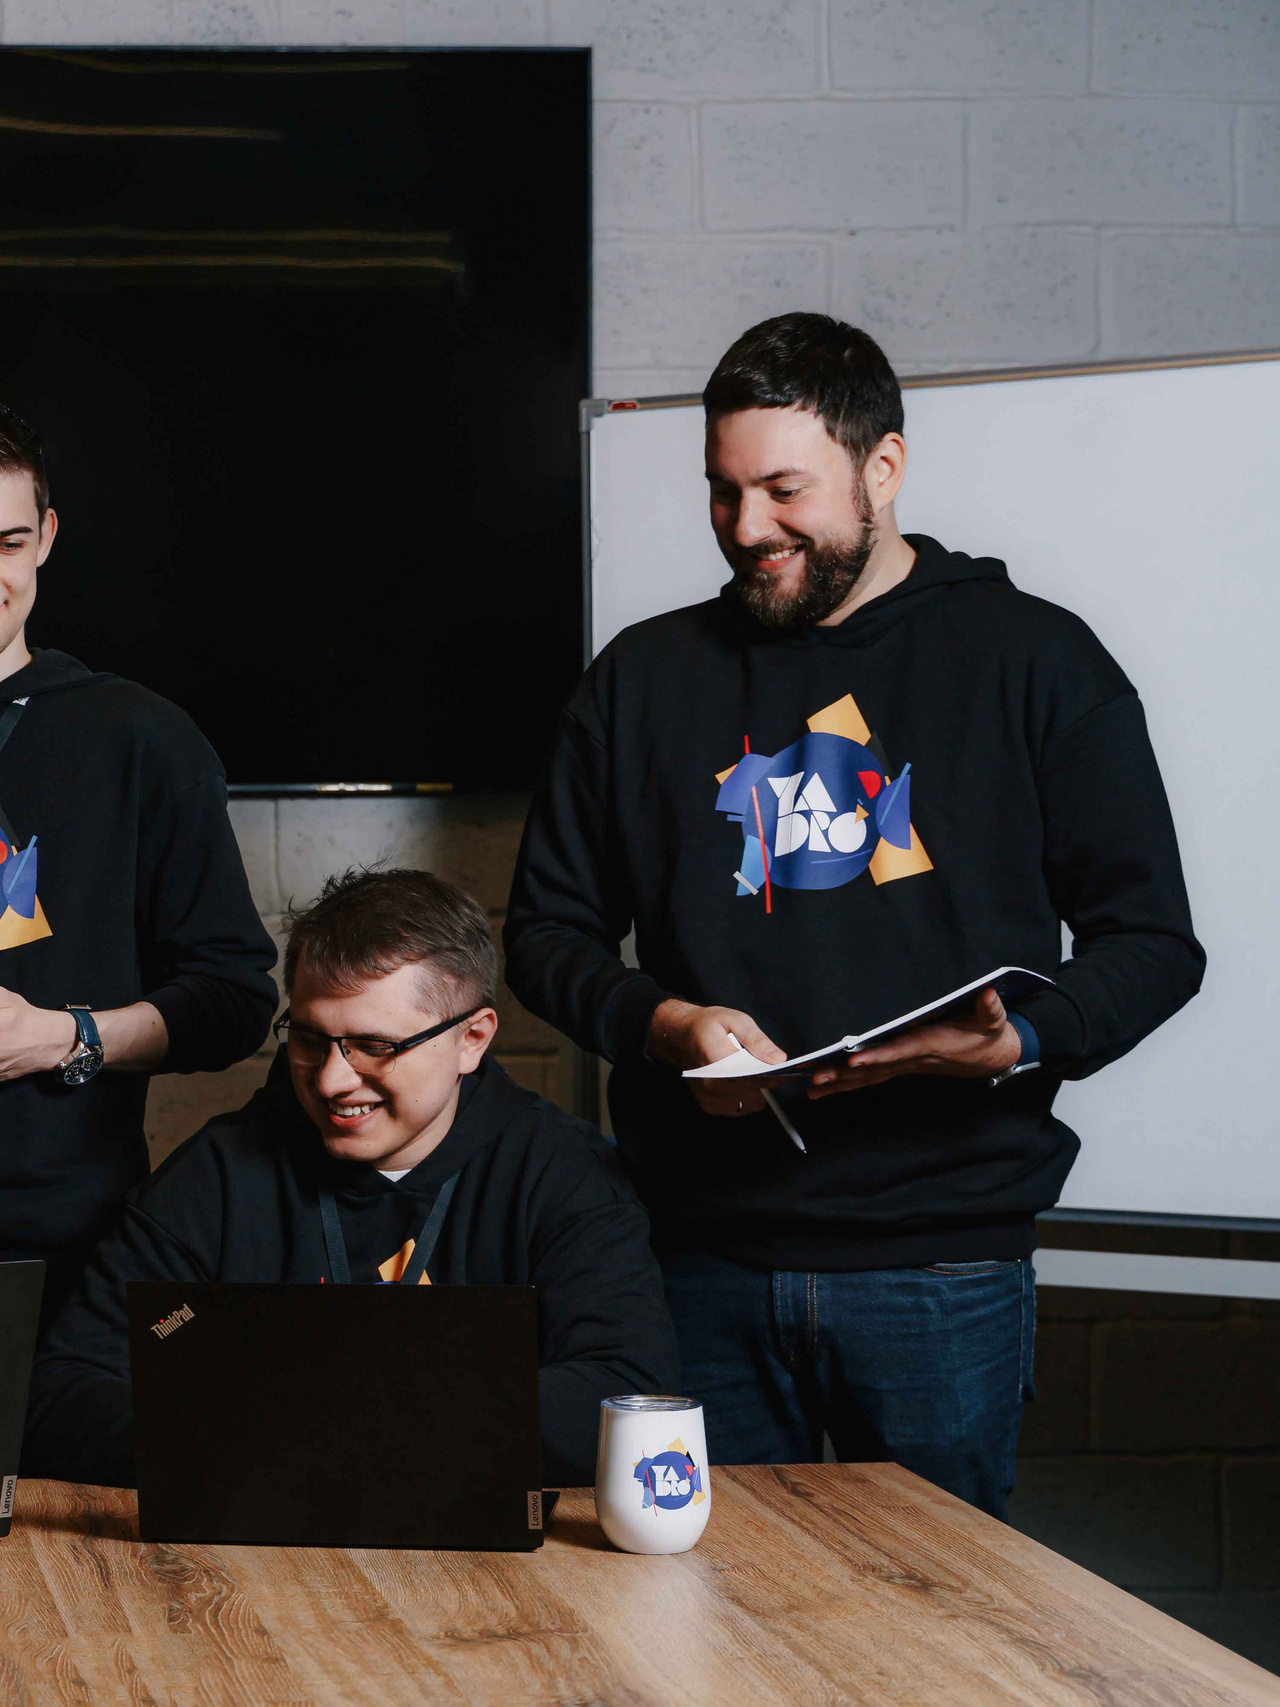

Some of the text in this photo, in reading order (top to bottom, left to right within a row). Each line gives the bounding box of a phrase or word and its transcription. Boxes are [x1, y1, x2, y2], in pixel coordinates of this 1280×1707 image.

[150, 1303, 195, 1339] ThinkPad
[1, 1479, 14, 1514] Lenovo
[531, 1494, 539, 1526] Lenovo
